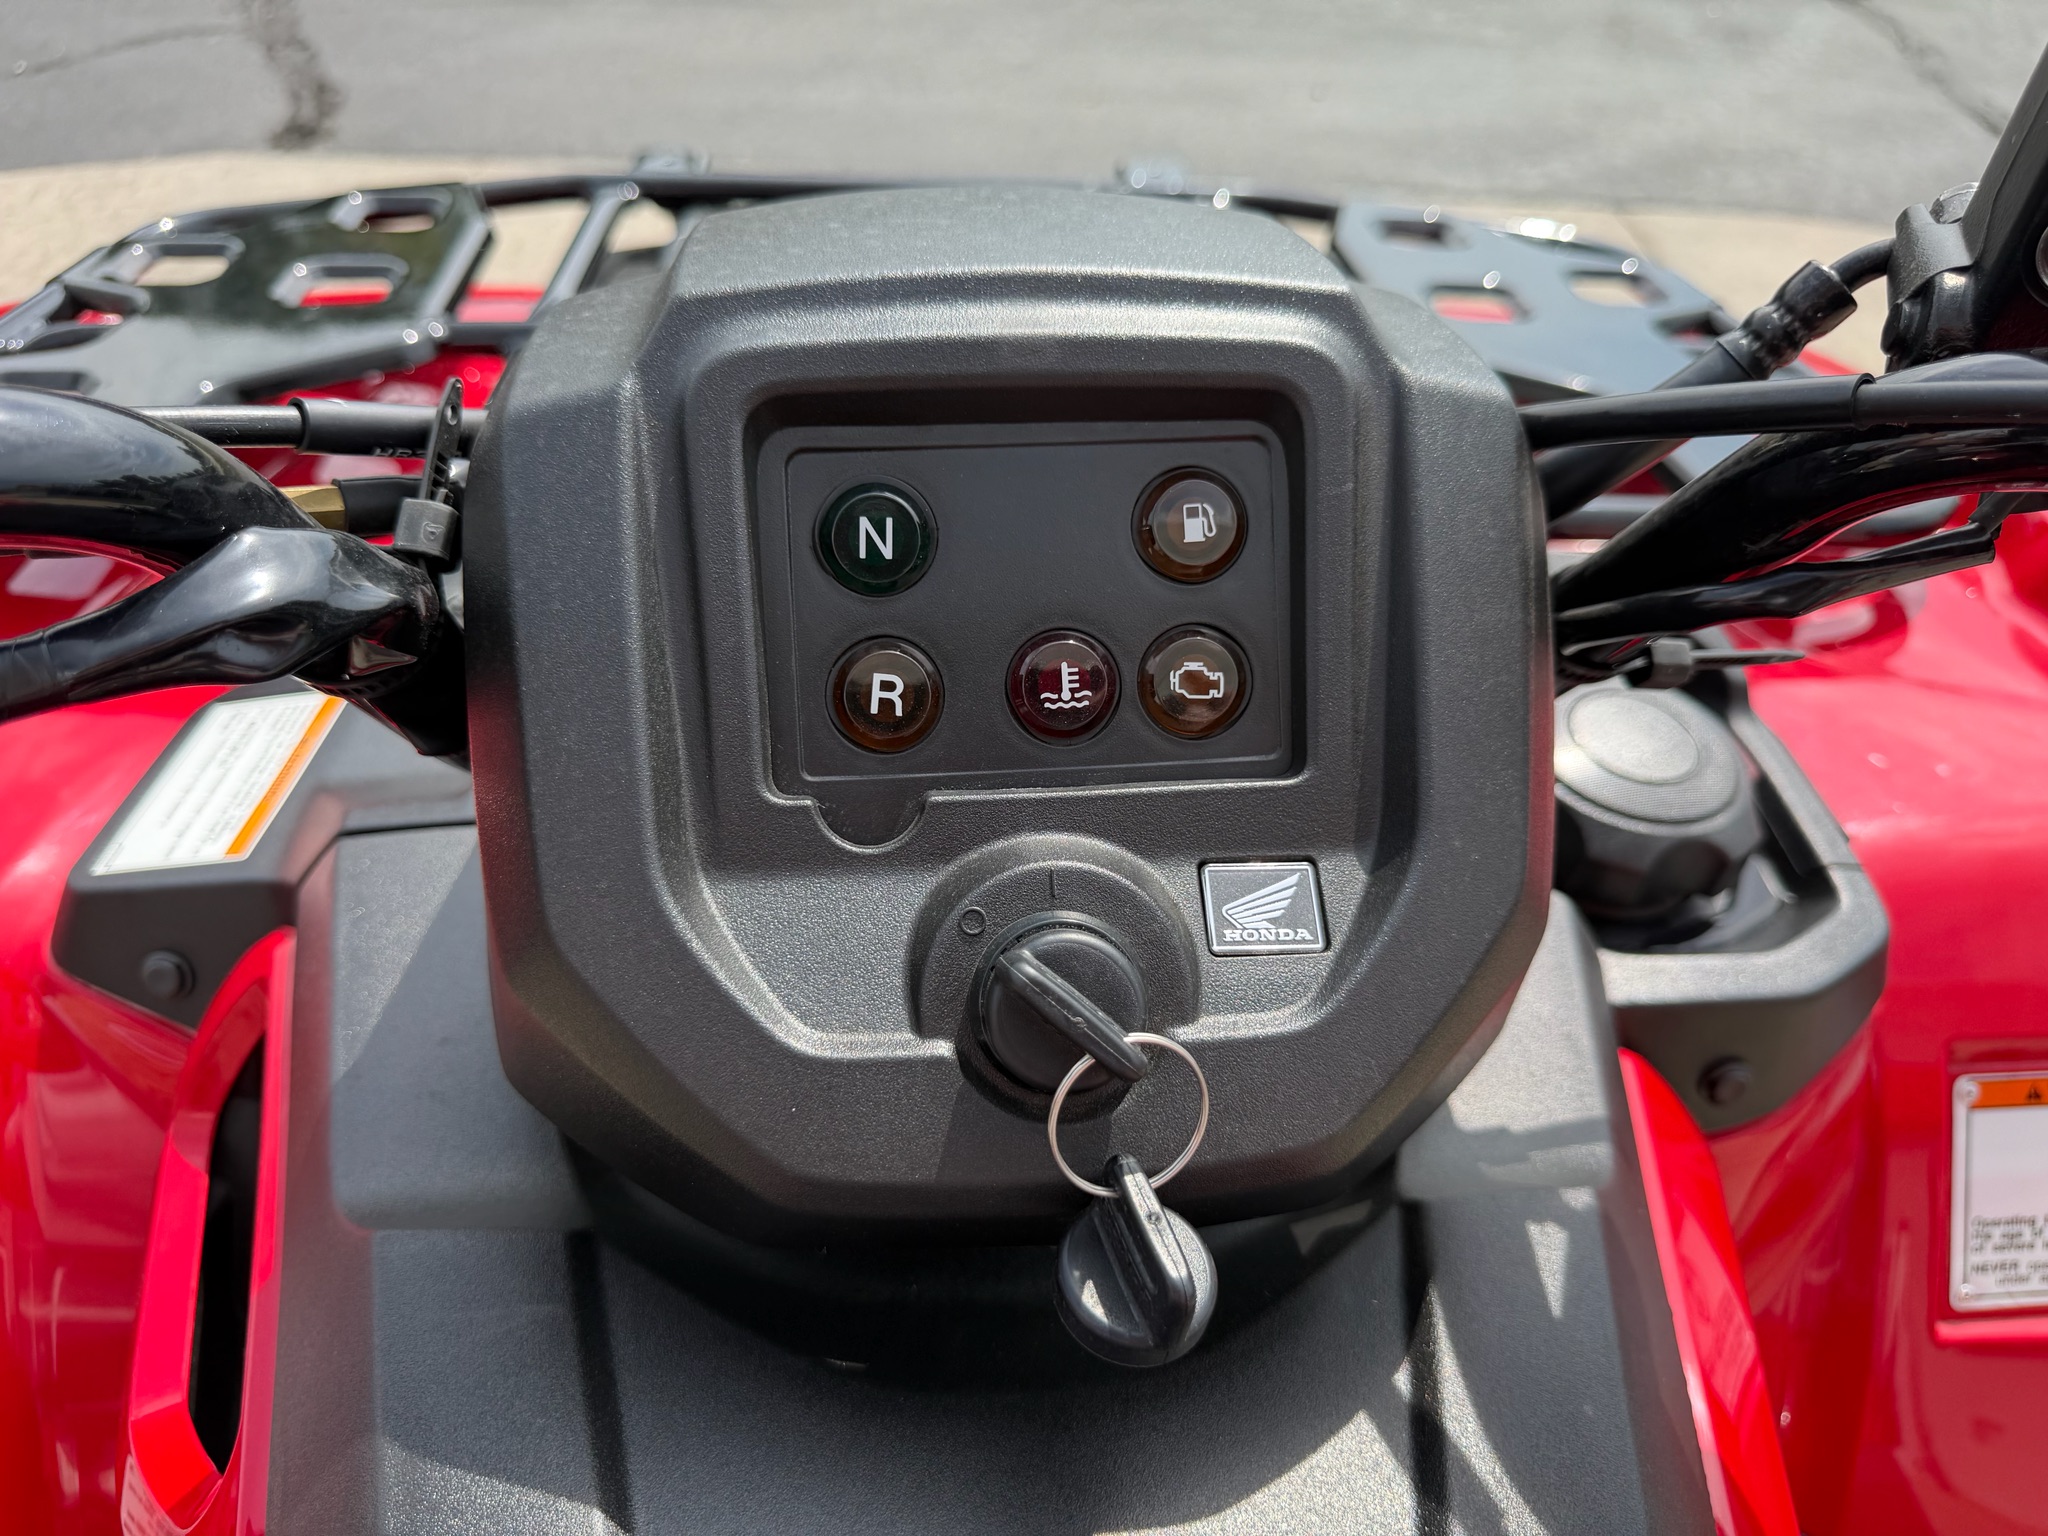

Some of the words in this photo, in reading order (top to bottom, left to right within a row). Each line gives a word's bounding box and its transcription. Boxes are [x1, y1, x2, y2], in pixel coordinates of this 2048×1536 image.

[858, 516, 893, 560] N
[870, 672, 904, 717] R
[1222, 928, 1314, 942] HONDA
[1970, 1261, 2018, 1274] NEVER
